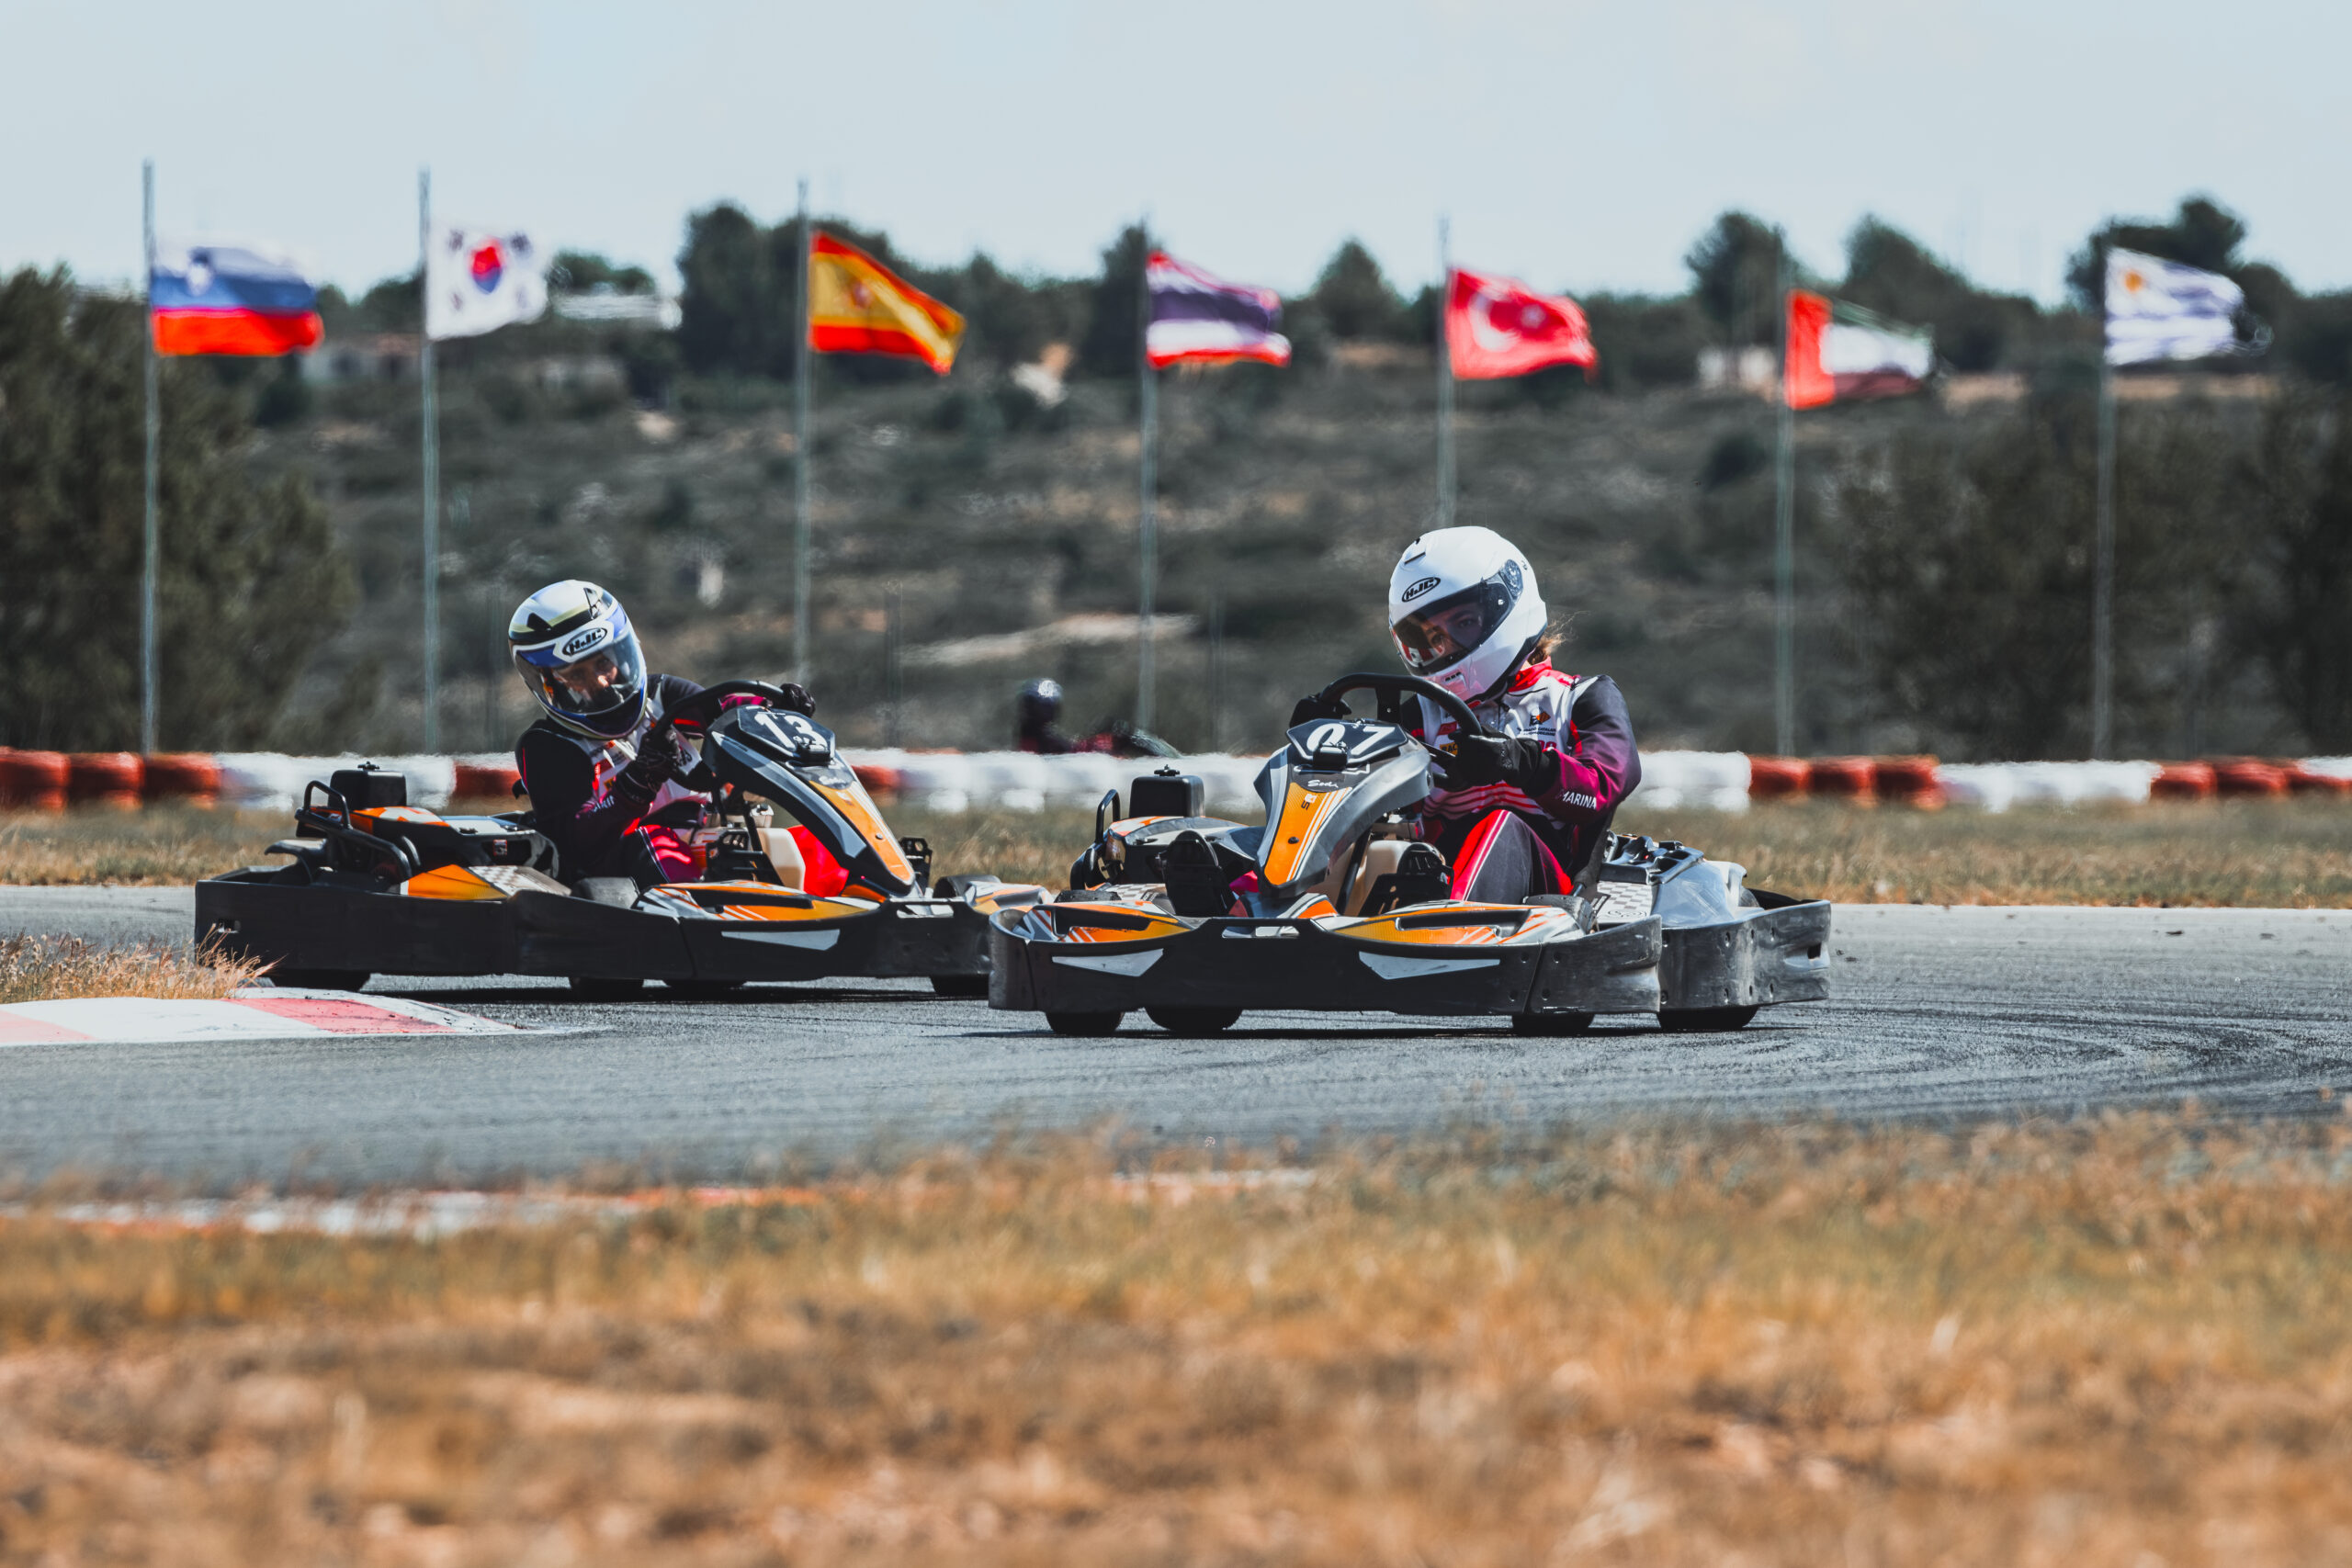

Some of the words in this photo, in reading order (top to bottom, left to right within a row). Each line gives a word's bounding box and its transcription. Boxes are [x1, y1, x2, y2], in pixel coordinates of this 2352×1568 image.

[1405, 578, 1435, 601] HJC
[569, 628, 603, 655] HJC
[754, 712, 829, 751] 13
[1306, 723, 1396, 755] 07
